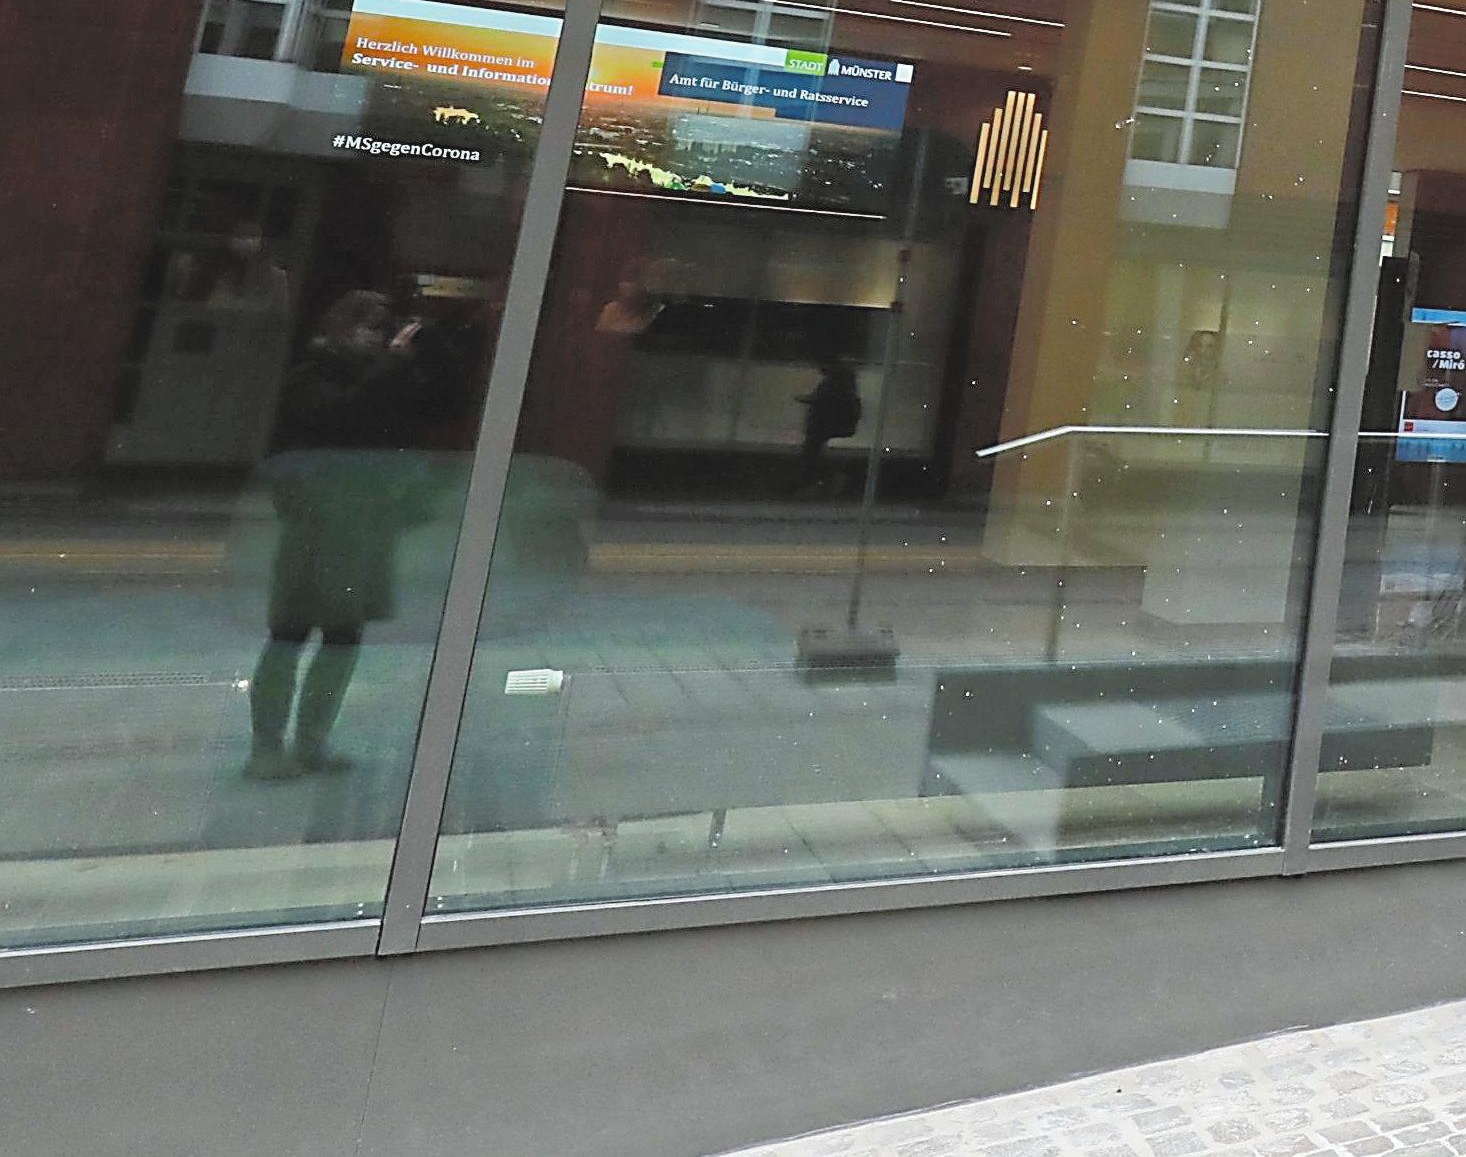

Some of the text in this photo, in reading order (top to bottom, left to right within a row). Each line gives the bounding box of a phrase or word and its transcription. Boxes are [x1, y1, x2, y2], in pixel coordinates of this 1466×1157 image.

[352, 53, 419, 71] Service-
[427, 62, 458, 75] und
[356, 37, 535, 68] Herzlich Willkommen im
[789, 58, 892, 81] STADT MÜNSTER
[669, 73, 869, 108] Amt für Bürger- und Ratsservice
[332, 134, 480, 161] #MSgegenCorona
[1427, 349, 1461, 359] casso
